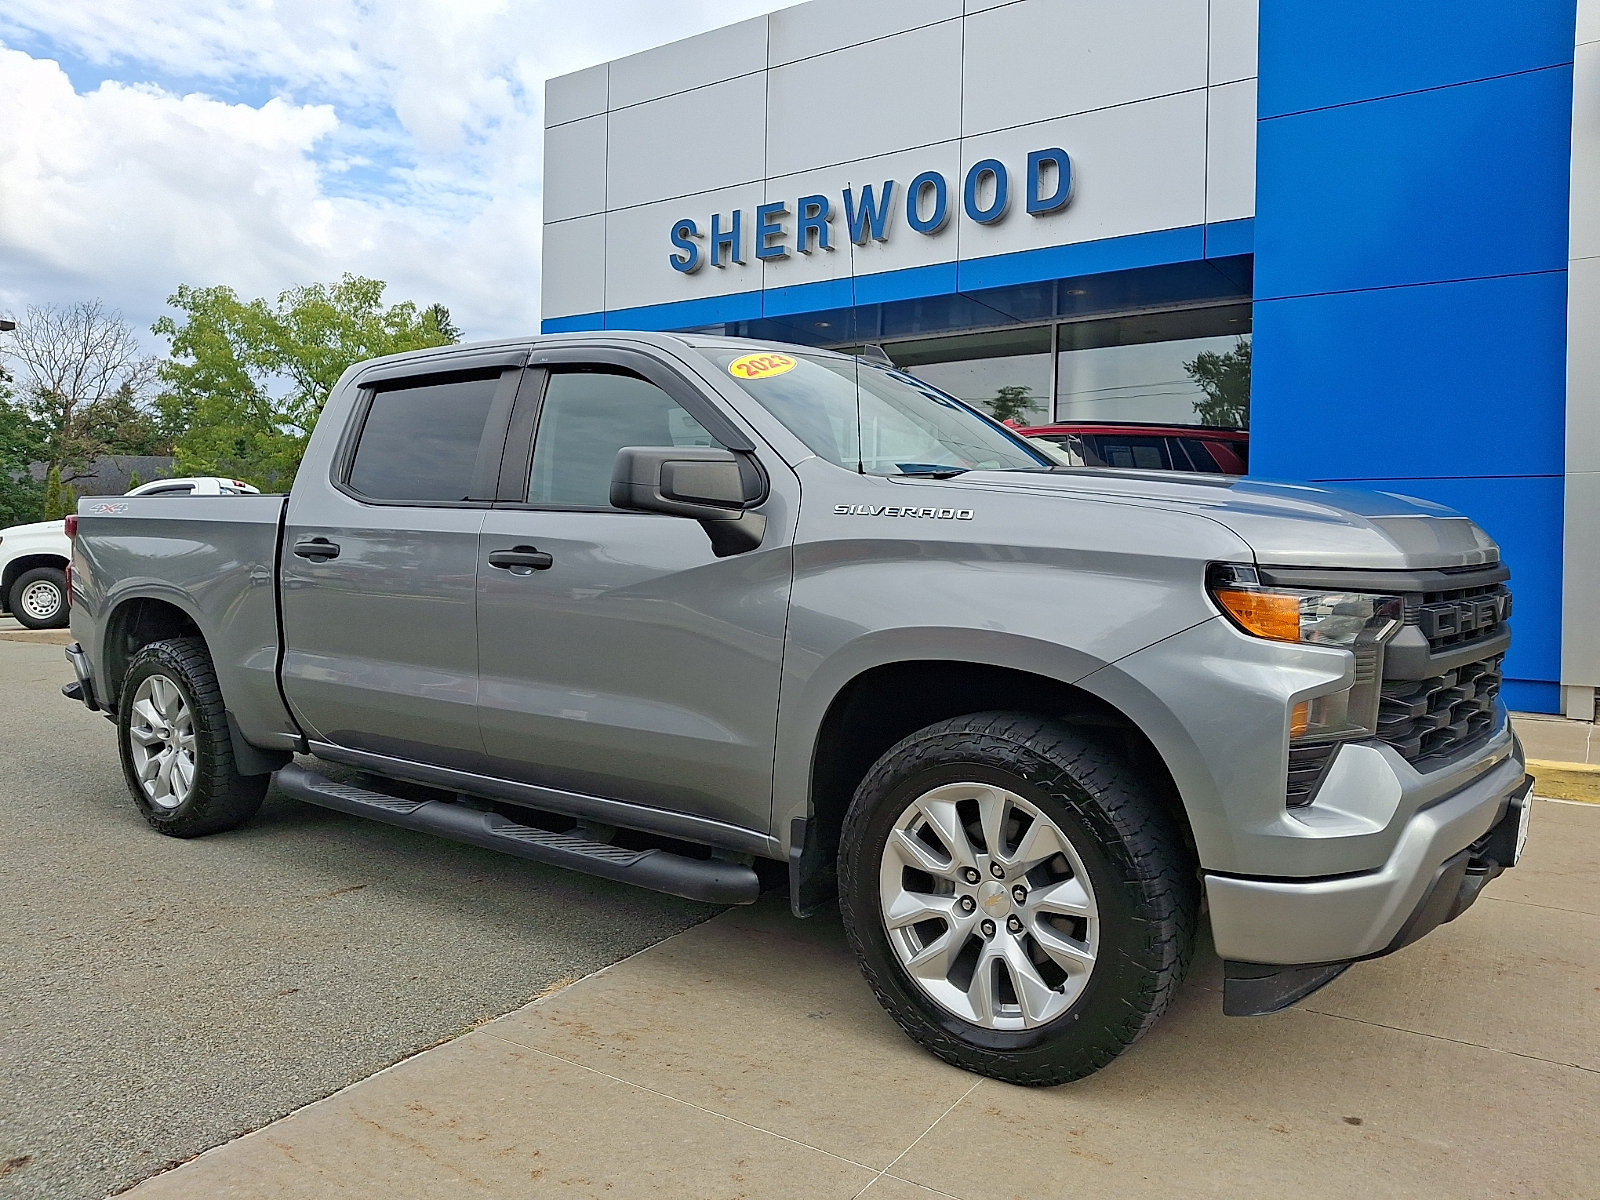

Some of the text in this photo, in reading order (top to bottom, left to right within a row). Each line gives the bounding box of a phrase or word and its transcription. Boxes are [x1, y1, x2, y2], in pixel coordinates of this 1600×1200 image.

[669, 147, 1073, 274] SHERWOOD
[737, 355, 792, 376] 2023
[833, 504, 975, 520] SILVERADO
[1420, 592, 1512, 639] CHEV
